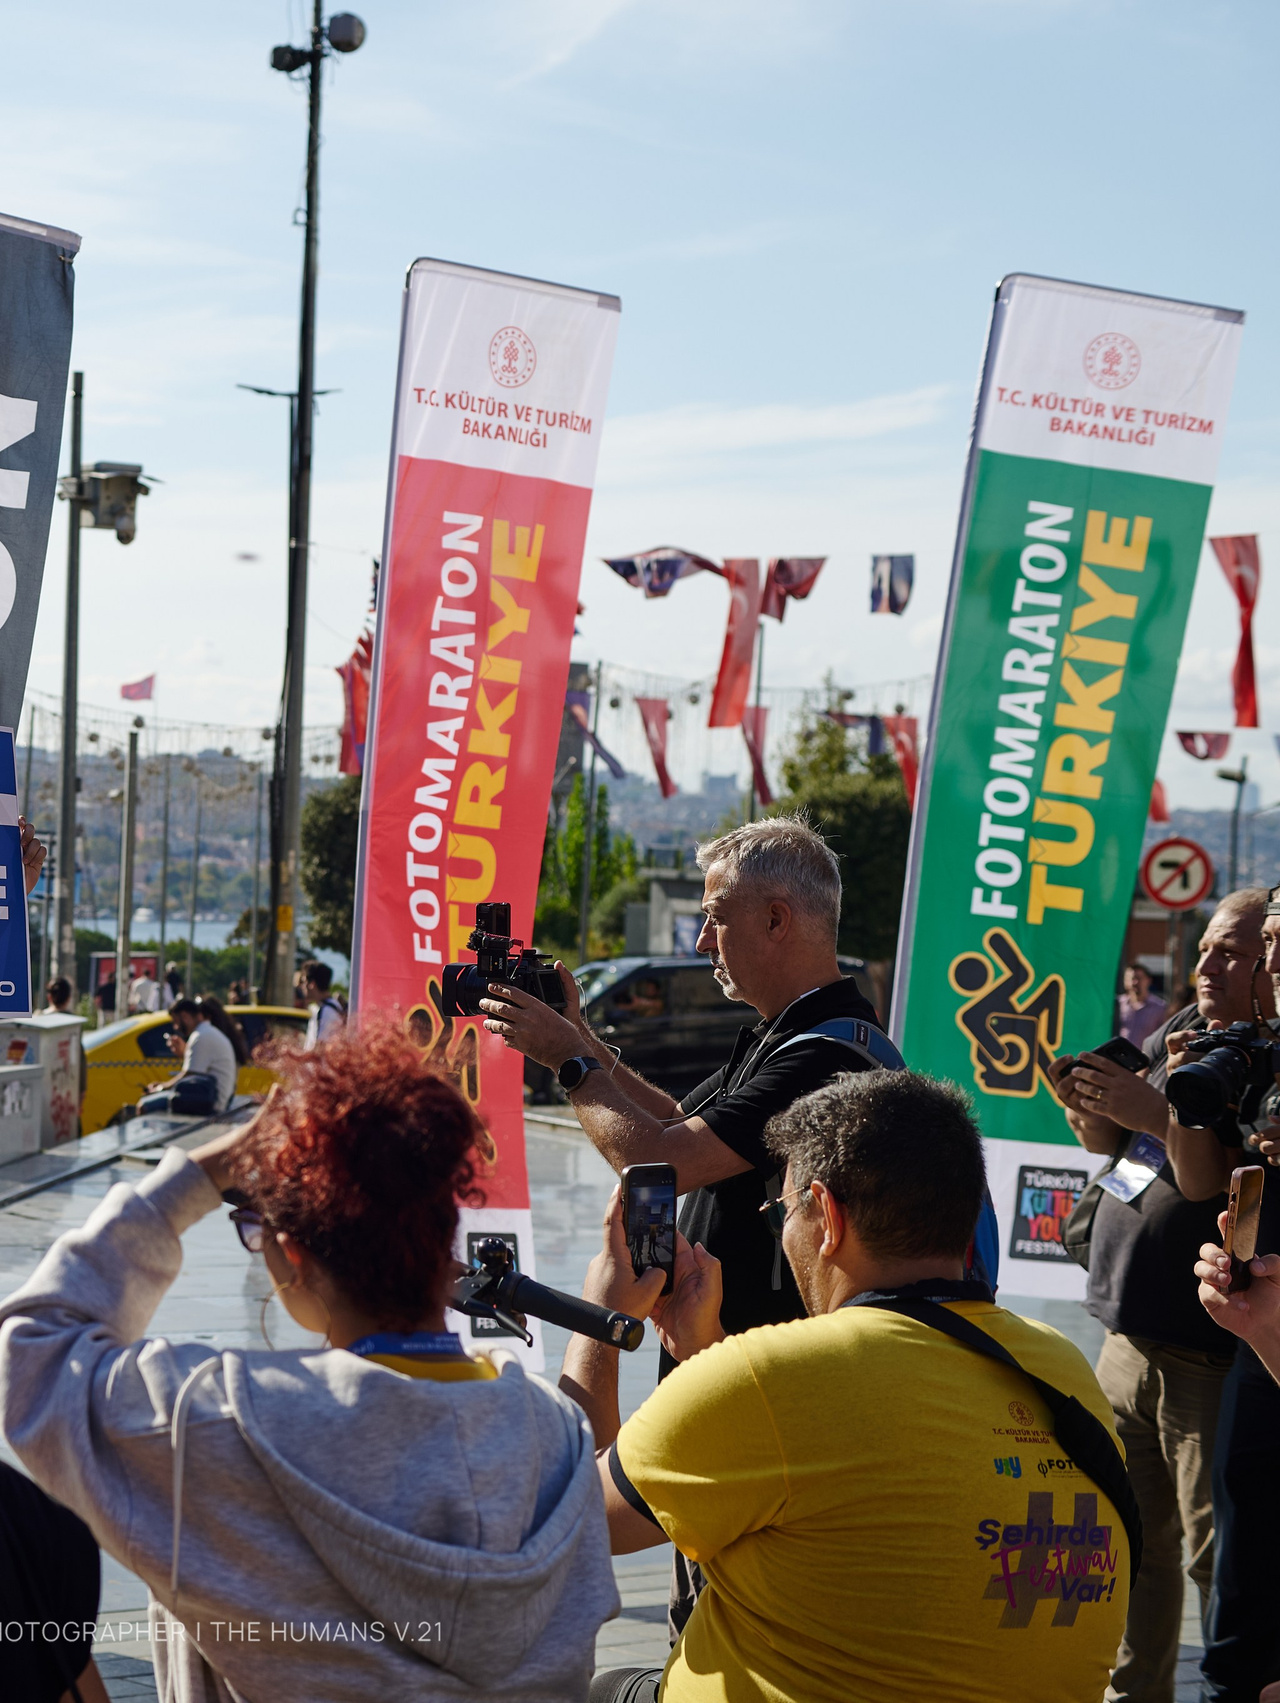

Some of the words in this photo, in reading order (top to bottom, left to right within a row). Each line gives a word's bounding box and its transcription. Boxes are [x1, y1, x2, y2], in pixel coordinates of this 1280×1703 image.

[413, 388, 439, 407] T.C.
[444, 391, 509, 418] KÜLTÜR
[514, 404, 532, 423] VE
[536, 409, 592, 434] TURİZM
[997, 386, 1026, 406] T.C.
[1031, 392, 1106, 418] KÜLTÜR
[1112, 406, 1136, 422] VE
[1142, 409, 1214, 435] TURİZM
[462, 418, 548, 448] BAKANLIĞI
[1050, 417, 1156, 446] BAKANLIĞI
[970, 500, 1074, 920] FOTOMARATON
[406, 511, 484, 964] FOTOMARATON
[1024, 1170, 1085, 1192] TÜRKİYE
[1020, 1187, 1081, 1220] KÜLTÜ
[1028, 1214, 1062, 1242] YOL
[1047, 1459, 1074, 1470] FOT
[975, 1518, 1105, 1550] Şehirde
[990, 1527, 1118, 1609] Festival
[1061, 1577, 1116, 1603] Var!
